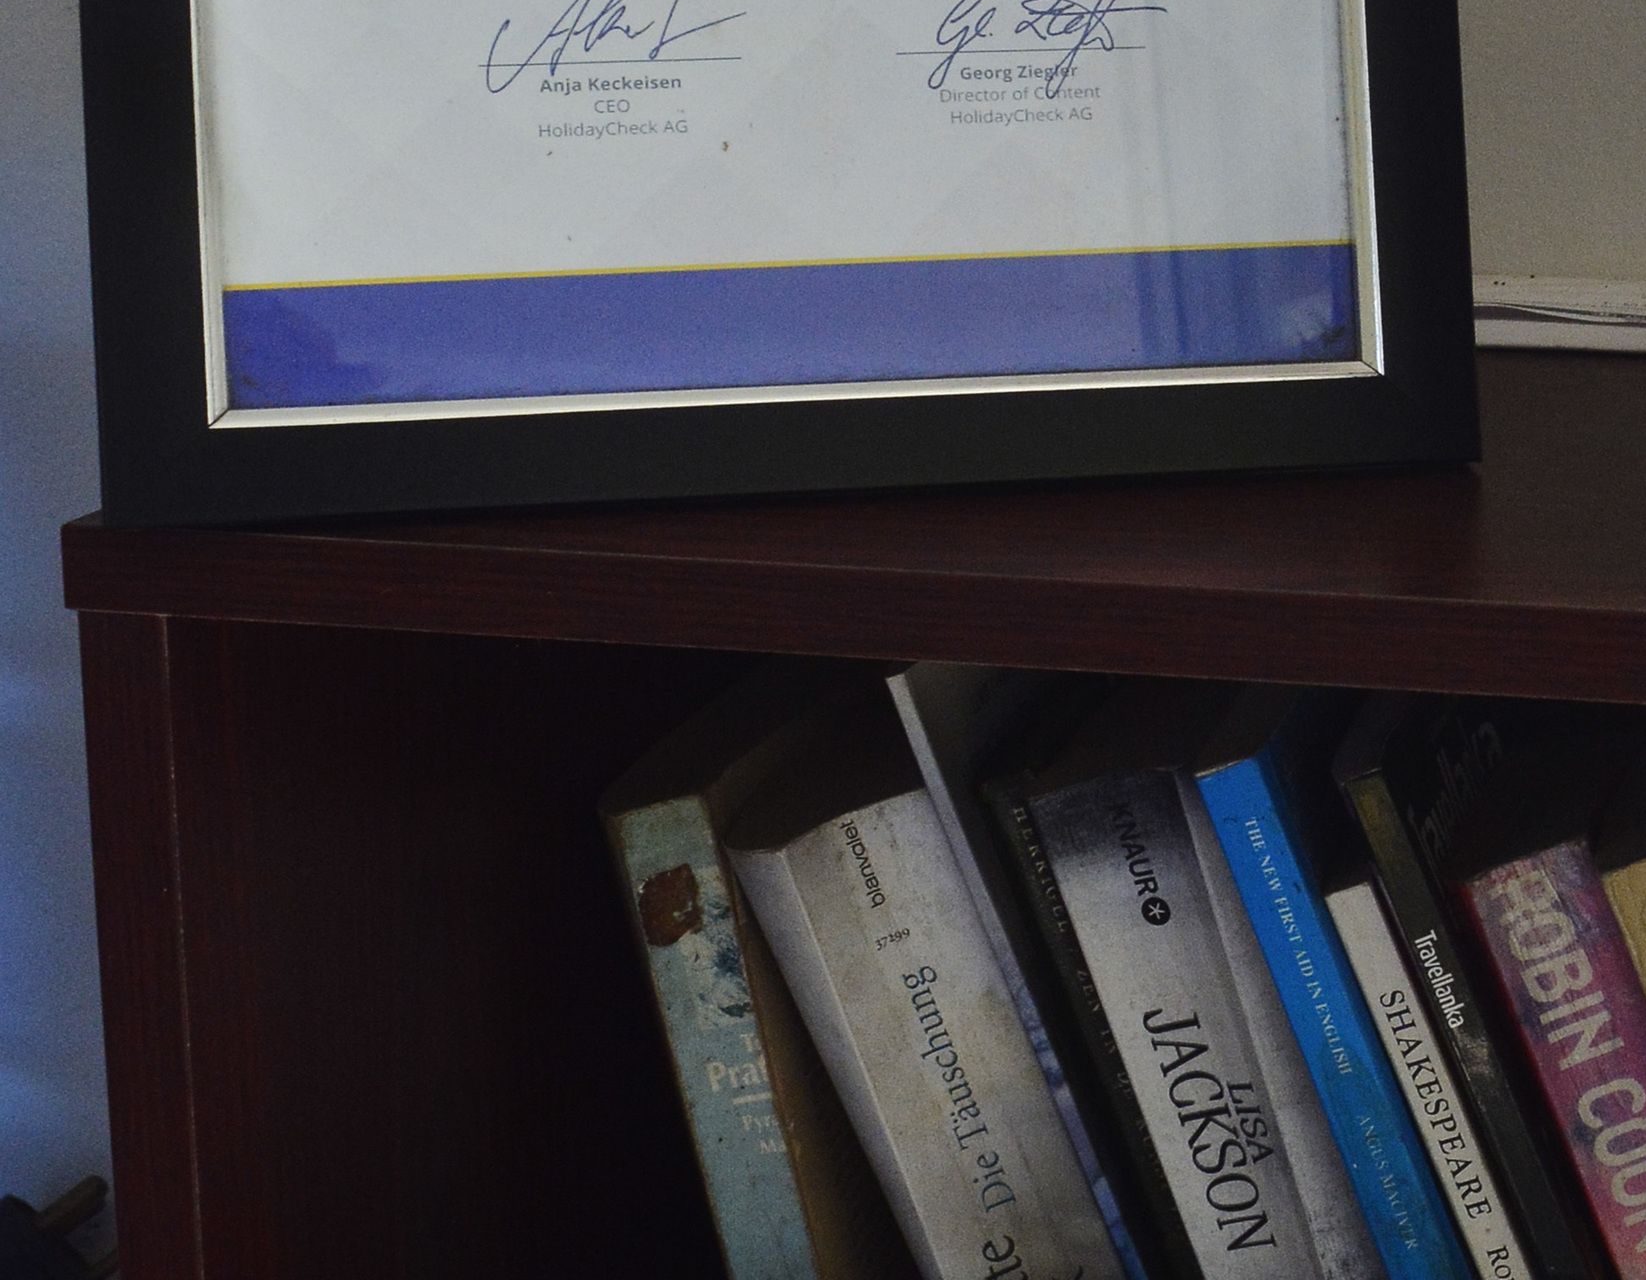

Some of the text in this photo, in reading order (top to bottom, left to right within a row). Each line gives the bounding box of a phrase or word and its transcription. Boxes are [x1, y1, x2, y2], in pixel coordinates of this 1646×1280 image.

[540, 76, 682, 95] Anja Keckeisen
[594, 99, 631, 113] CEO
[940, 85, 1101, 103] Director of Content
[950, 107, 1093, 126] HolidayCheck AG
[960, 65, 1078, 82] Georg Ziegler
[538, 120, 688, 139] HolidayCheck AG
[839, 818, 886, 909] blanvalet
[1110, 803, 1160, 897] KNAUR
[1243, 817, 1353, 1076] THE NEW FIRST AID IN ENGLISH
[1413, 928, 1466, 1031] Travellanka
[1489, 868, 1626, 1073] ROBIN
[902, 965, 1016, 1213] Die Täuschung
[1143, 1007, 1278, 1253] JACKSON
[1227, 1080, 1274, 1166] LISA
[1379, 989, 1492, 1219] SHAKESPEARE
[1358, 1114, 1388, 1171] ANGUS
